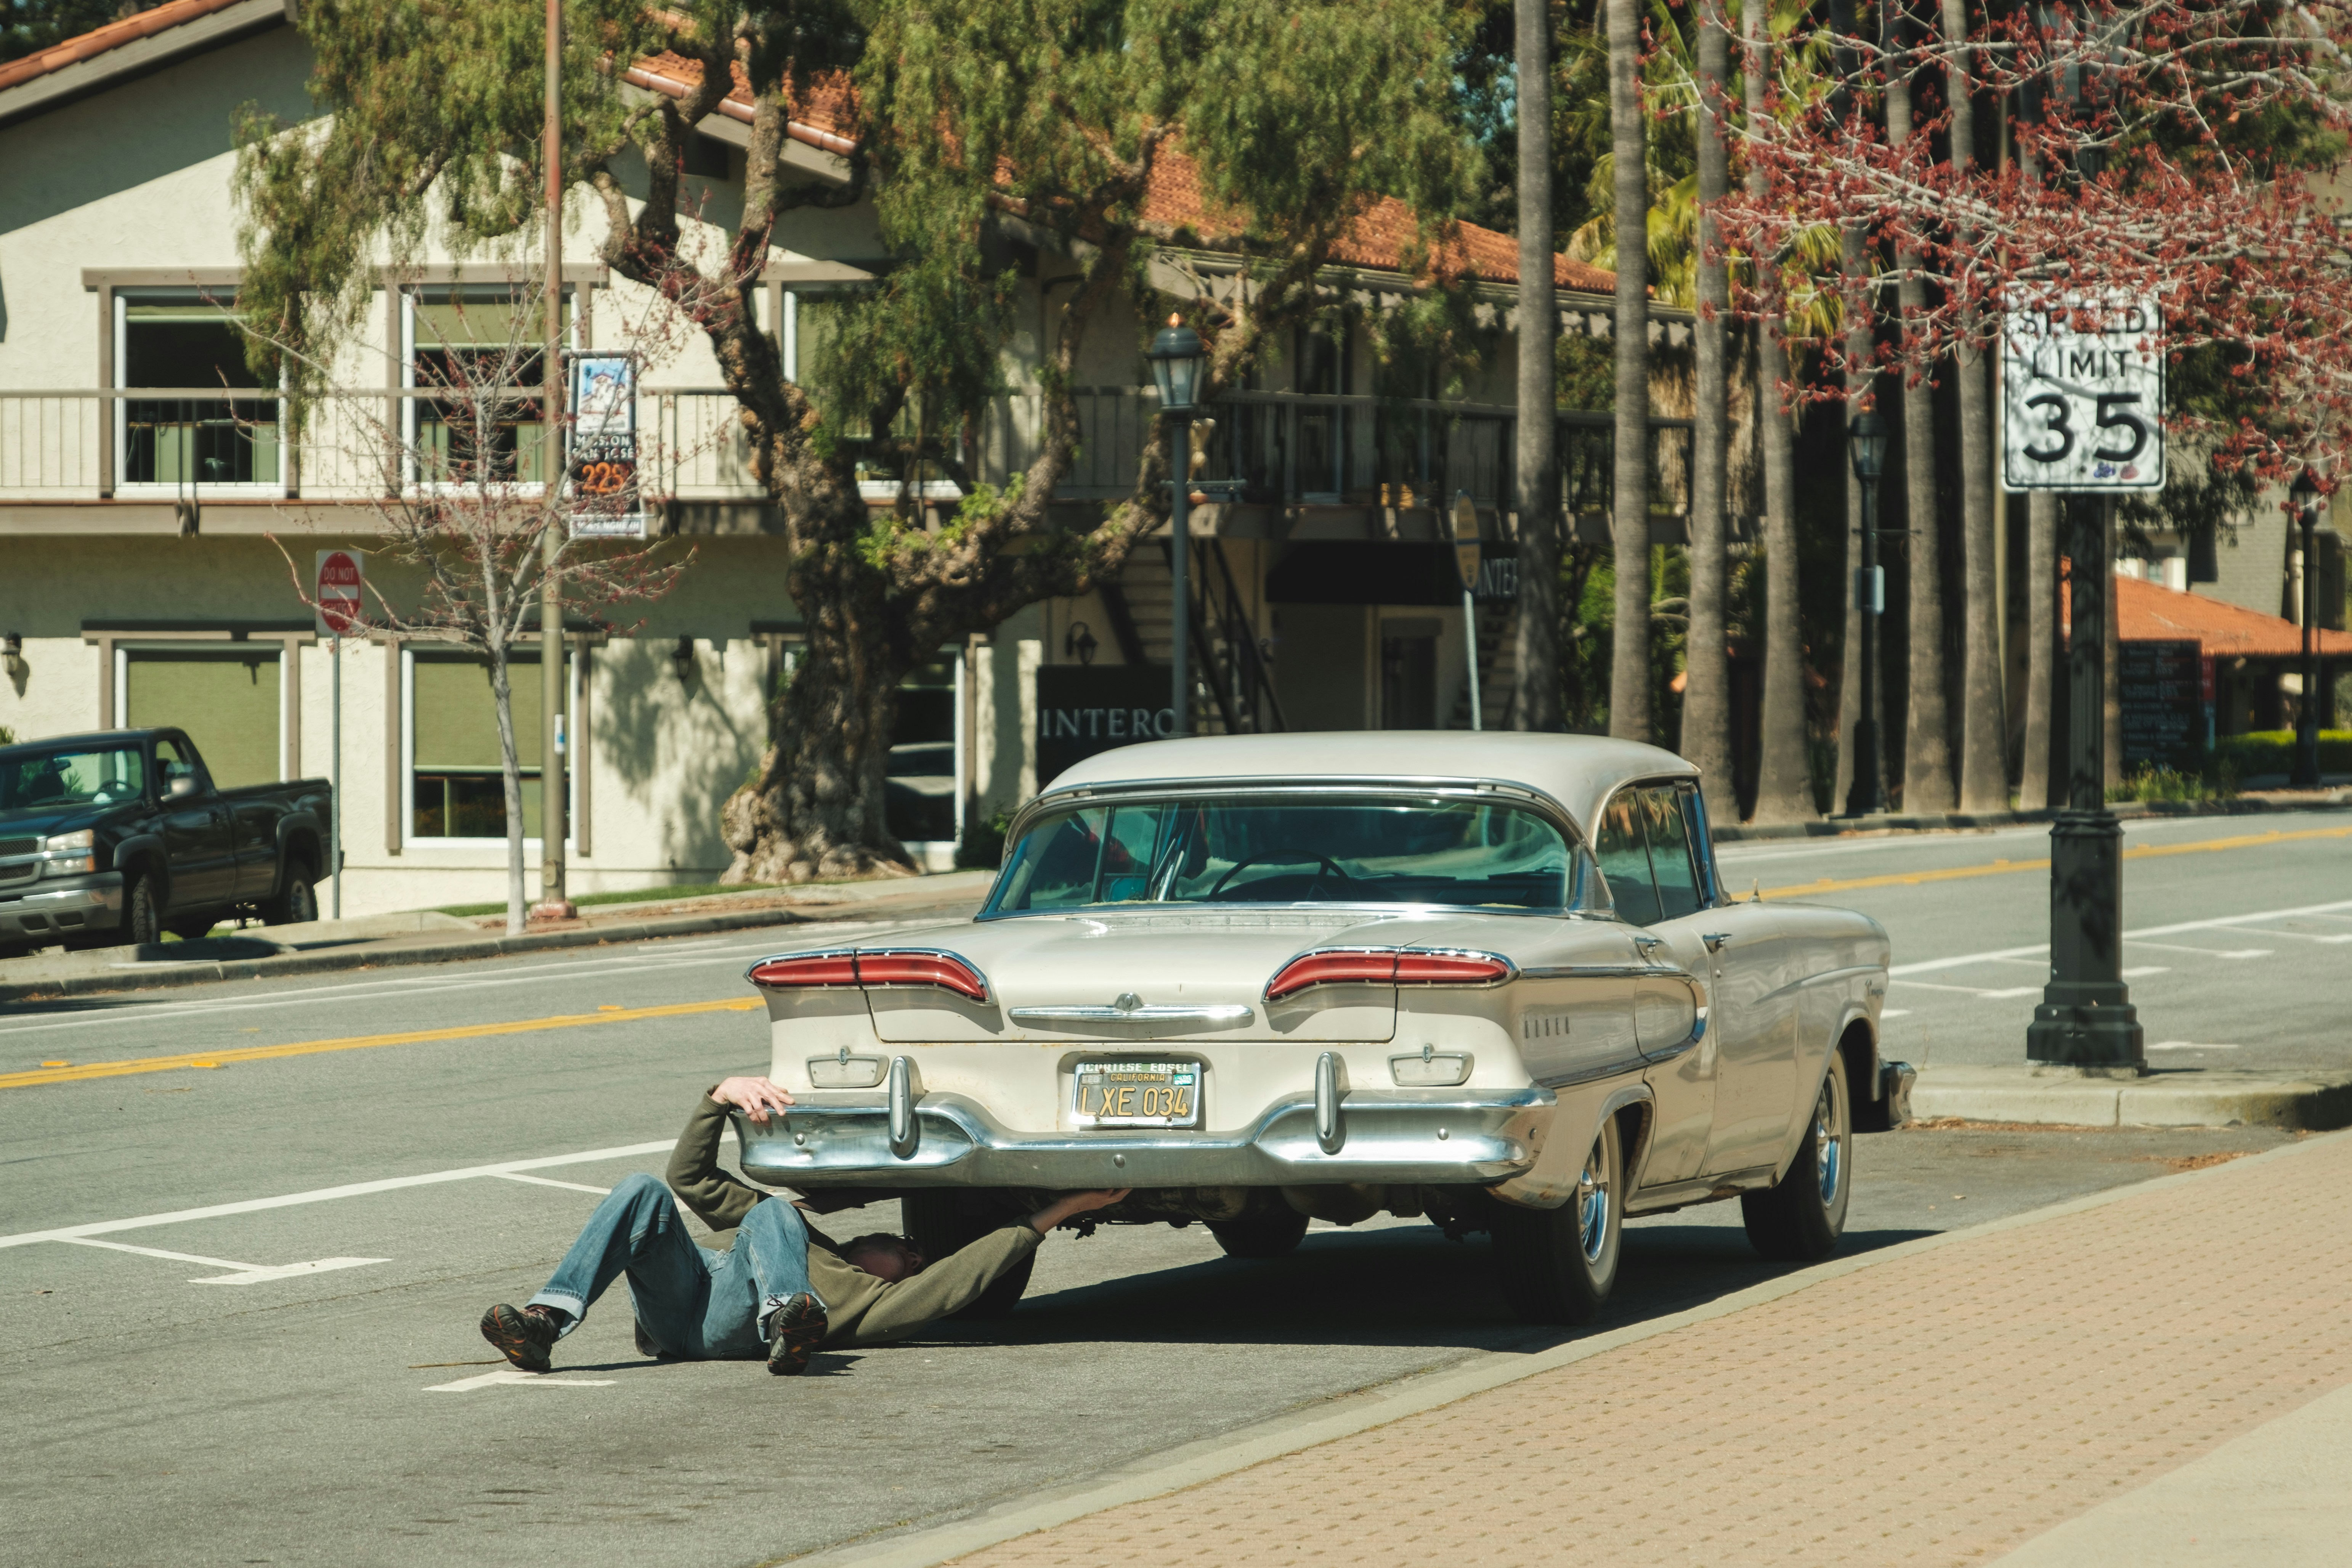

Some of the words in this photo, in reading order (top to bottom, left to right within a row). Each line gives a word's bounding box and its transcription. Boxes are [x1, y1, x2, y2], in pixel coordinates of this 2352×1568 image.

[2033, 350, 2132, 377] LIMIT
[2022, 392, 2147, 462] 35
[324, 567, 335, 580] DO
[338, 567, 354, 580] NOT
[1150, 1063, 1189, 1072] EDSEL
[1110, 1074, 1165, 1082] CALIFORNIA
[1081, 1087, 1136, 1116] LXE
[1143, 1087, 1189, 1116] 034
